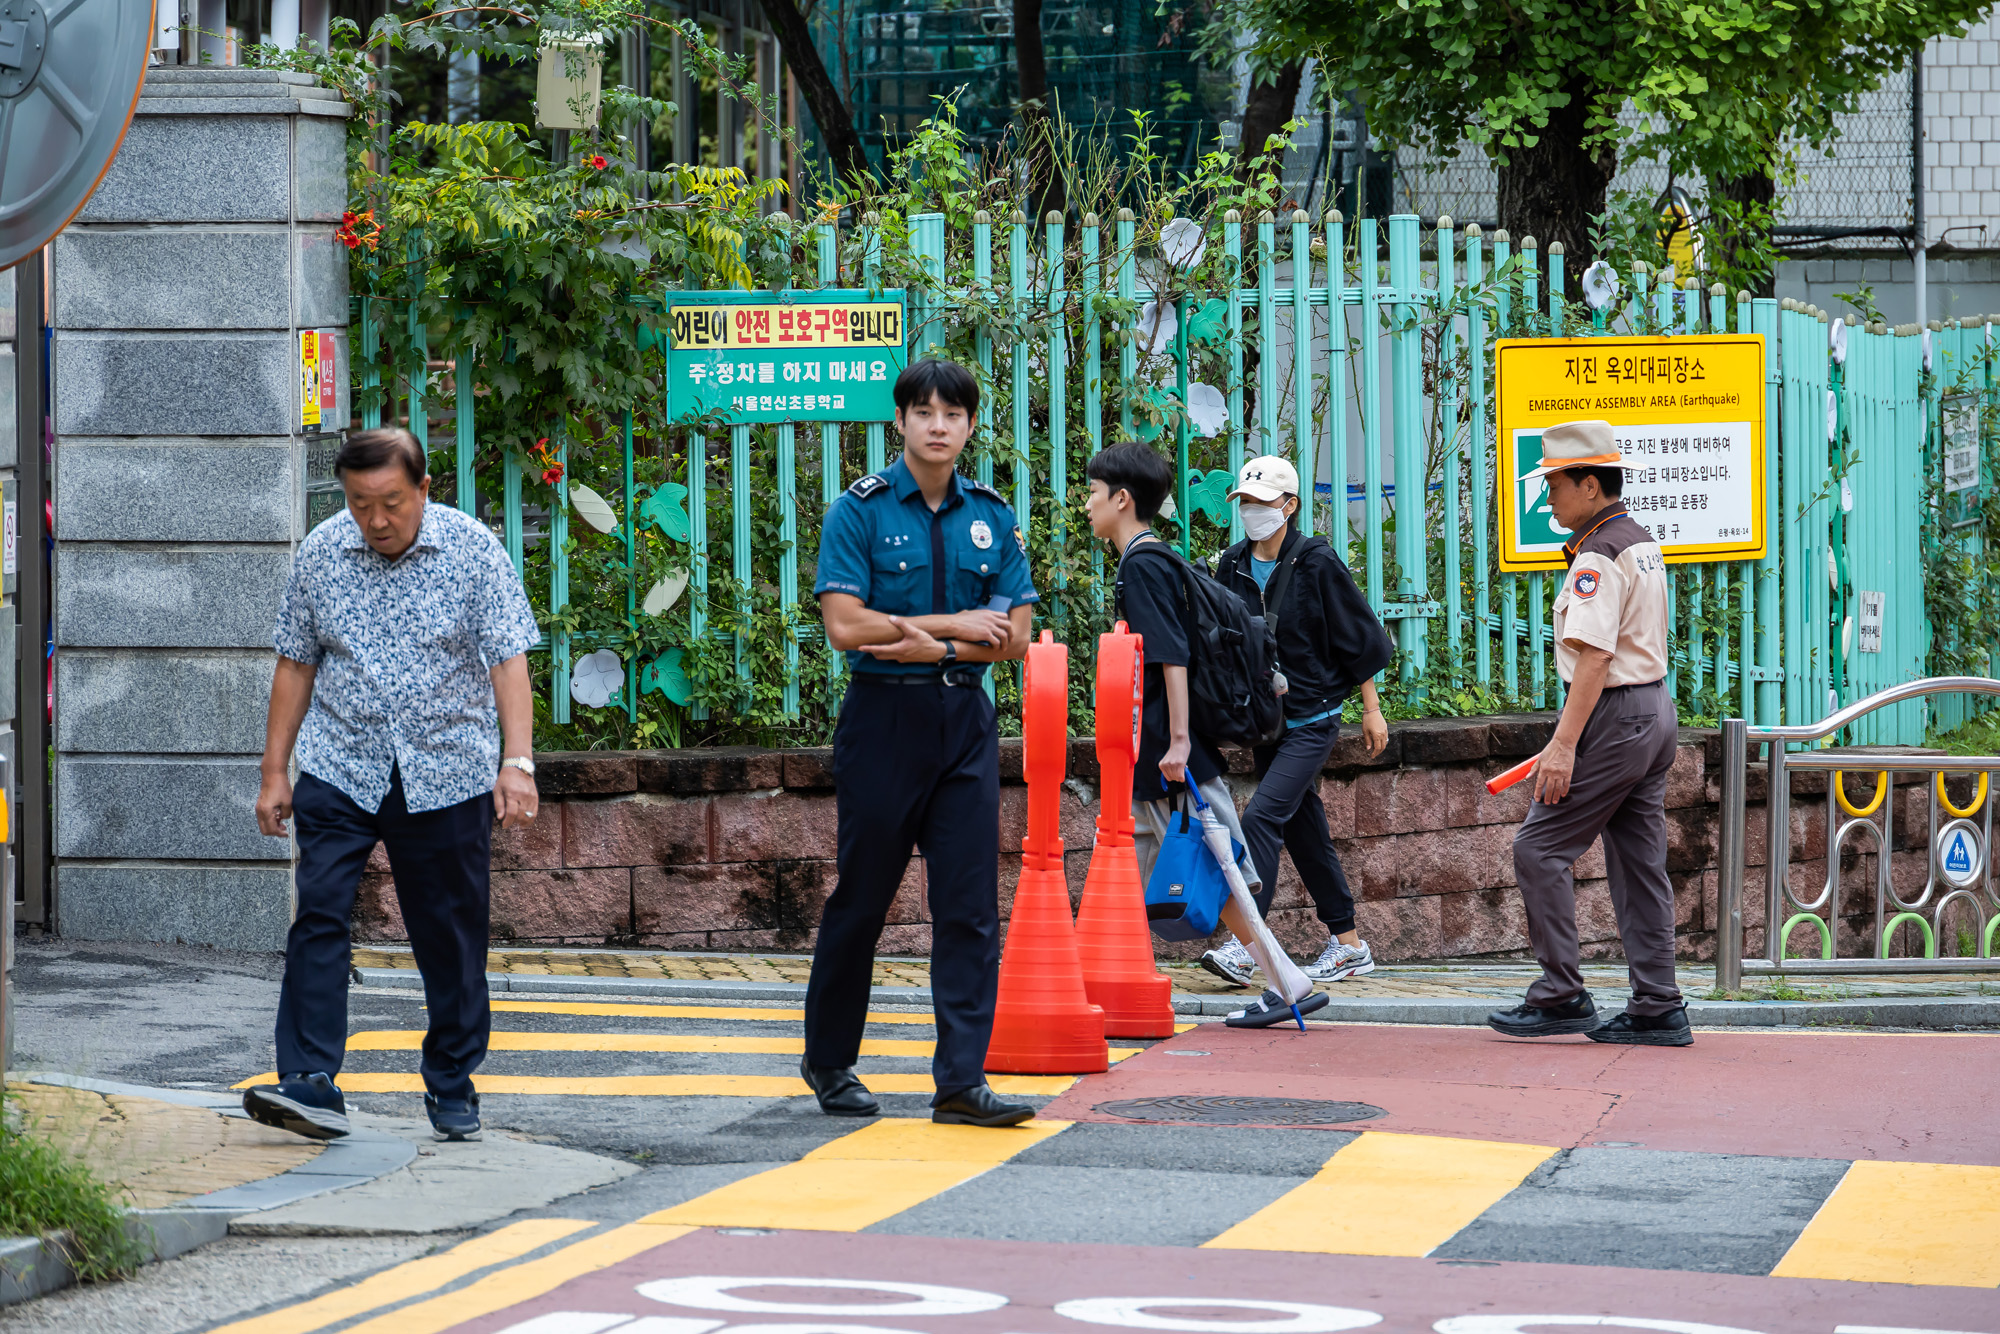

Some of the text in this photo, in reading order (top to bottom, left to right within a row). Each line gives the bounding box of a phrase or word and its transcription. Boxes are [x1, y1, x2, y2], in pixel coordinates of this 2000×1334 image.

[675, 308, 899, 344] 어린이 안전 보호구역입니다
[782, 361, 821, 383] 하지
[828, 360, 887, 382] 마세요
[1565, 356, 1706, 385] 지진 옥외대피장소
[732, 395, 846, 412] 서울연신초등학교
[1528, 392, 1741, 412] EMERGENCY ASSEMBLY AREA (Earthquake)
[1637, 438, 1656, 455] 지진
[1660, 437, 1689, 454] 발생에
[1693, 436, 1731, 453] 대비하여
[1661, 465, 1731, 483] 대피장소입니다.
[1680, 493, 1709, 510] 운동장
